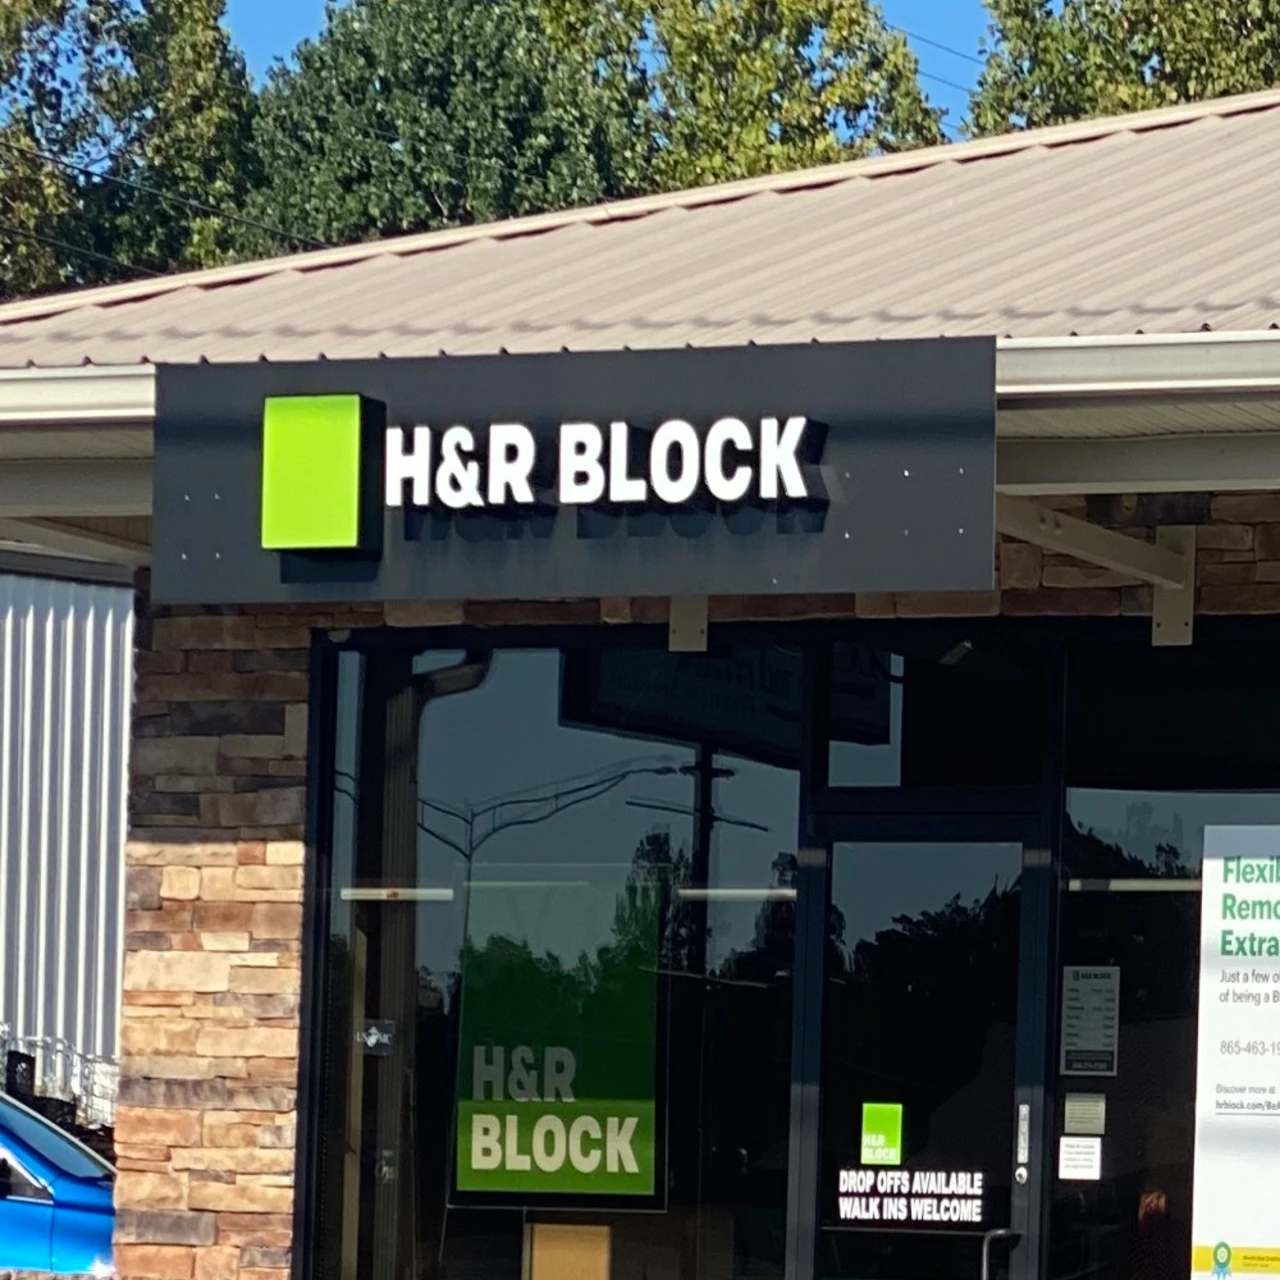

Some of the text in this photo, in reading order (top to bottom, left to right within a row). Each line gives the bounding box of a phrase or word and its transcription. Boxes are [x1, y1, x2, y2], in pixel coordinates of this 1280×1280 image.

[385, 416, 808, 508] H&R BLOCK
[1220, 929, 1280, 957] Extra
[1220, 969, 1240, 984] Just
[1242, 973, 1249, 983] a
[1251, 969, 1270, 983] few
[1219, 989, 1230, 1003] of
[1232, 989, 1261, 1006] being
[1263, 992, 1270, 1003] a
[472, 1045, 578, 1102] H&R
[470, 1114, 640, 1174] BLOCK
[839, 1169, 983, 1196] DROP OFFS AVAILABLE
[838, 1196, 983, 1223] WALK INS WELCOME
